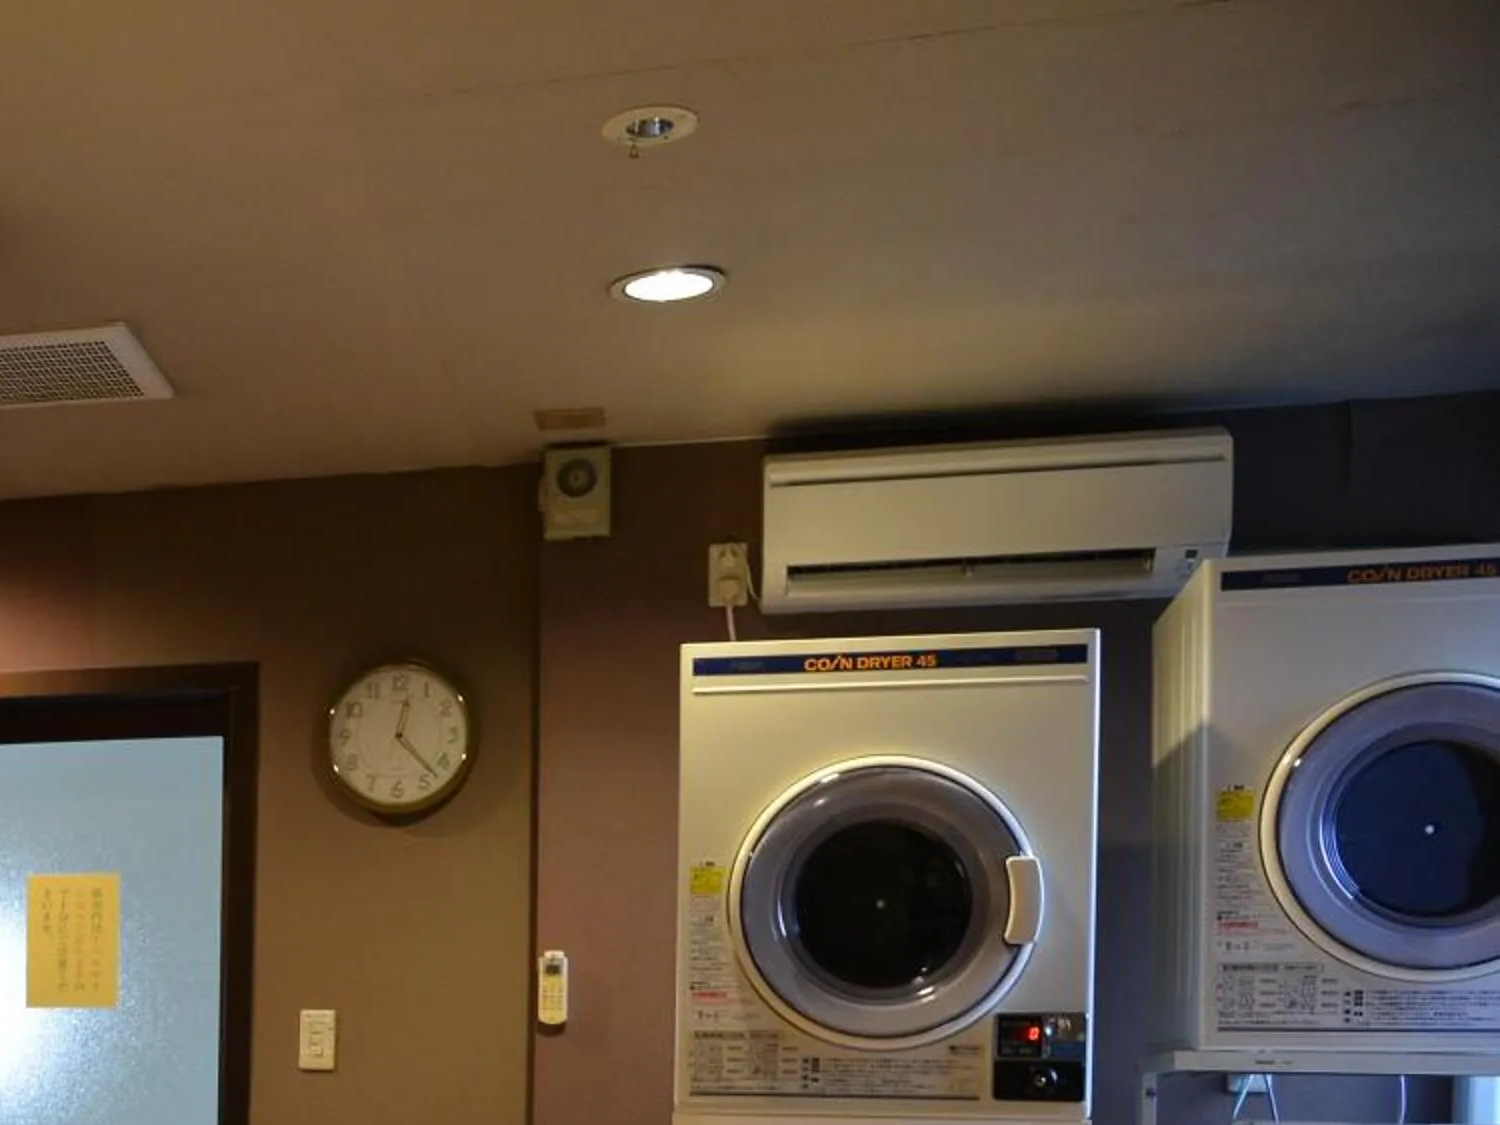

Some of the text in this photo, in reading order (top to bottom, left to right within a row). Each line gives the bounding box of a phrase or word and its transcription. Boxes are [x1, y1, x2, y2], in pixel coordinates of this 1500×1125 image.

[856, 655, 913, 670] DRYER
[915, 654, 937, 668] 45
[366, 681, 380, 700] 11
[391, 672, 410, 692] 12
[423, 680, 430, 699] 1
[345, 701, 363, 719] 10
[438, 701, 453, 718] 2
[338, 728, 352, 747] 9
[446, 726, 459, 744] 3
[346, 753, 358, 772] 8
[436, 751, 451, 770] 4
[365, 773, 378, 794] 7
[389, 779, 405, 799] 6
[417, 773, 432, 791] 5
